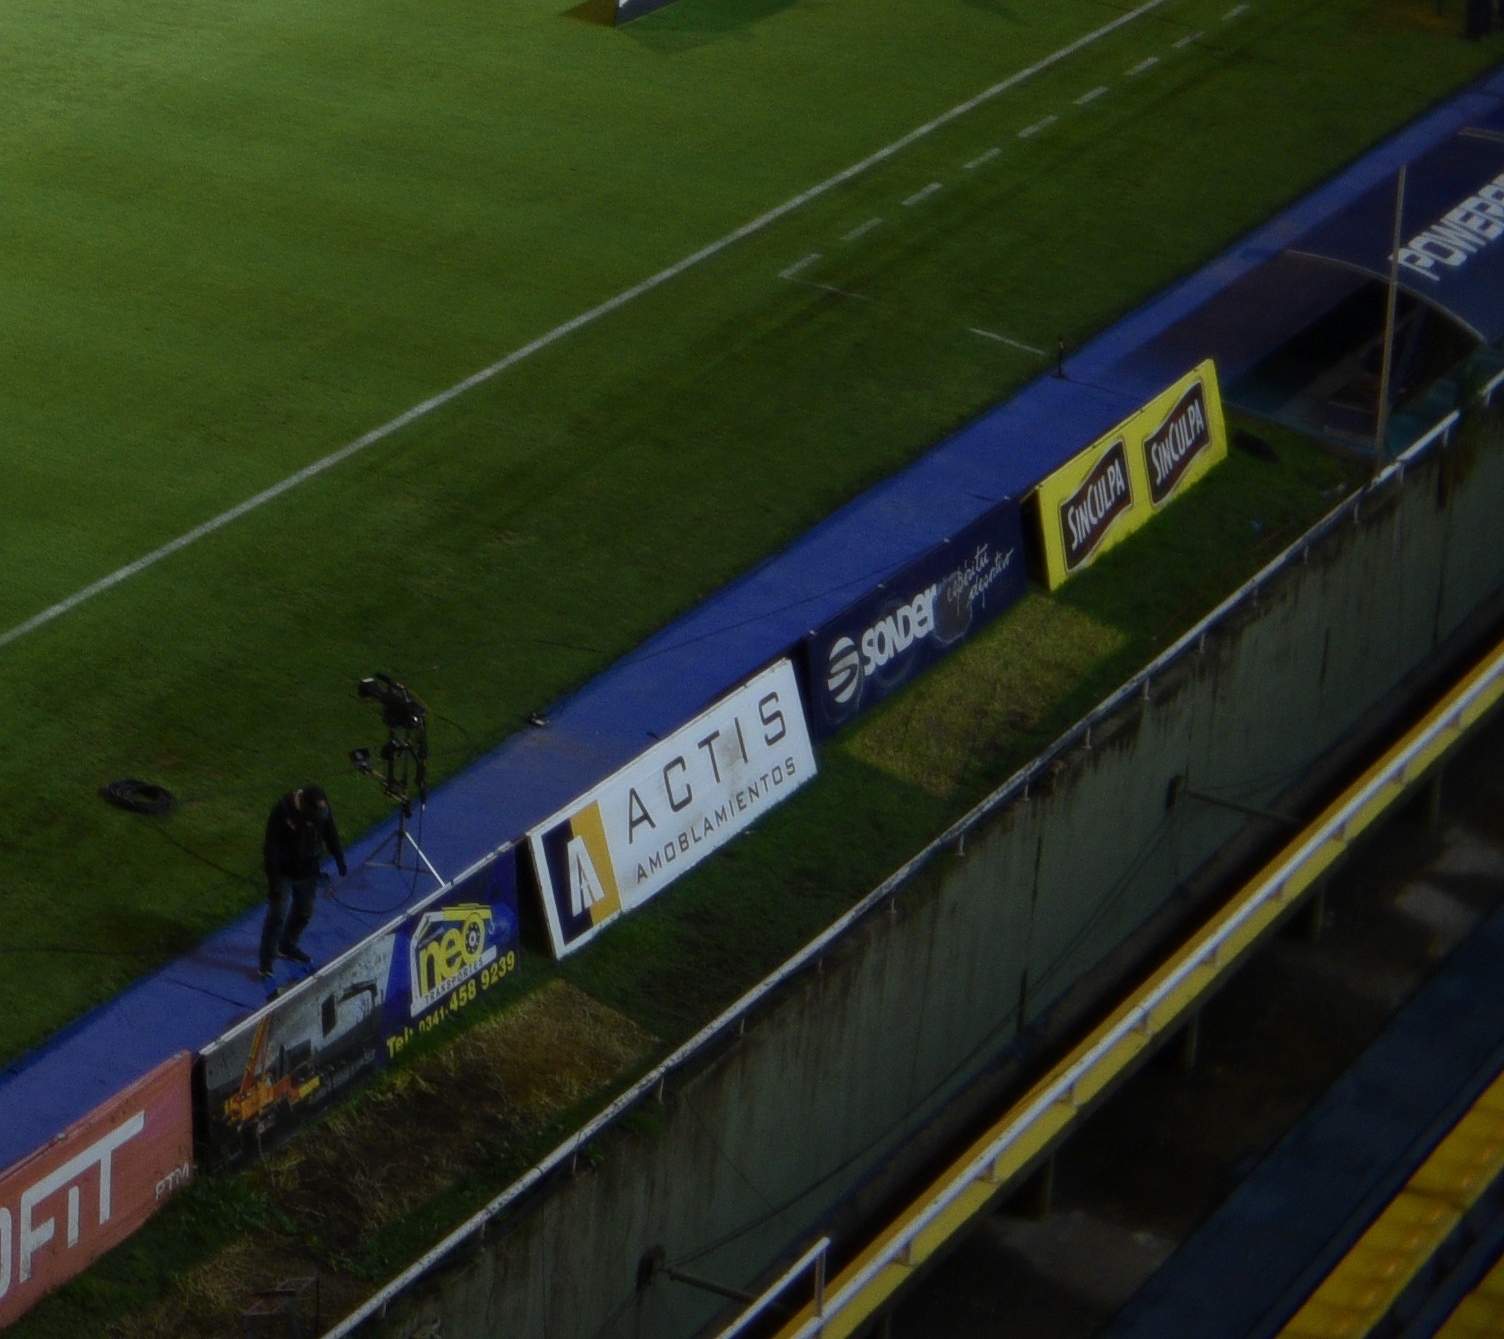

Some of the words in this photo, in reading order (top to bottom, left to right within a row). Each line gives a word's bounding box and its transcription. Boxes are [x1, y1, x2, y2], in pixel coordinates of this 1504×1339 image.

[629, 690, 786, 845] ACTIS
[636, 756, 796, 884] AMOBLAMIENTOS
[419, 912, 486, 999] neo
[480, 949, 516, 991] 9239
